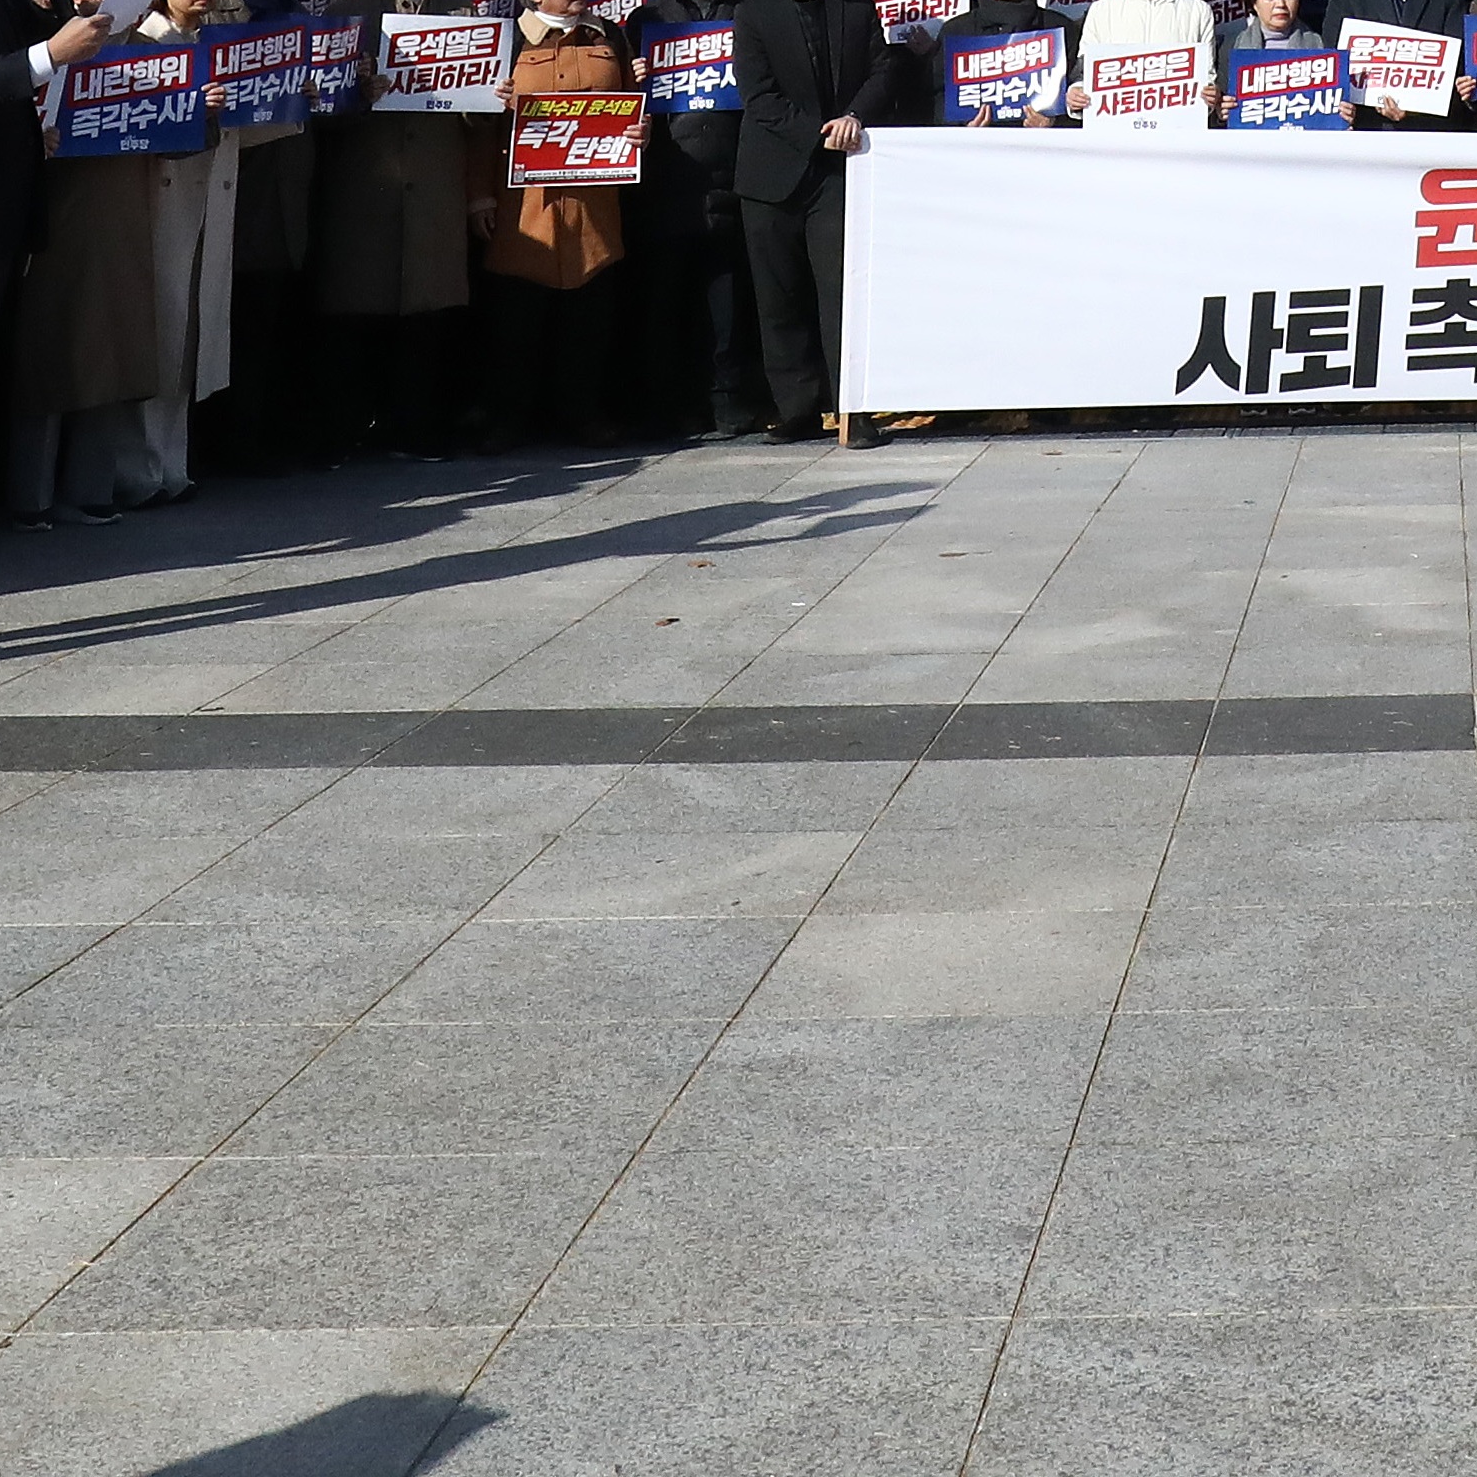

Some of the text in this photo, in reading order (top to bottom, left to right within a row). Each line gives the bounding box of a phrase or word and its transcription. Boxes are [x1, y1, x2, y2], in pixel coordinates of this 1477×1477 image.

[214, 29, 304, 77] 내란행위
[395, 27, 495, 64] 윤석열은
[957, 38, 1051, 80] 내란행위
[1349, 35, 1443, 64] 윤석열은
[72, 54, 190, 100] 내란행위
[388, 61, 499, 95] 사퇴하라!
[1096, 57, 1190, 89] 윤석열은
[1240, 59, 1335, 95] 내란행위
[71, 91, 195, 139] 즉각수사!
[521, 100, 638, 116] 내란수괴 윤석열
[1096, 83, 1197, 116] 사퇴하라!
[1240, 90, 1342, 124] 즉각수사!
[517, 121, 579, 148] 즉각
[565, 136, 632, 165] 탄핵!
[1175, 284, 1383, 396] 사퇴
